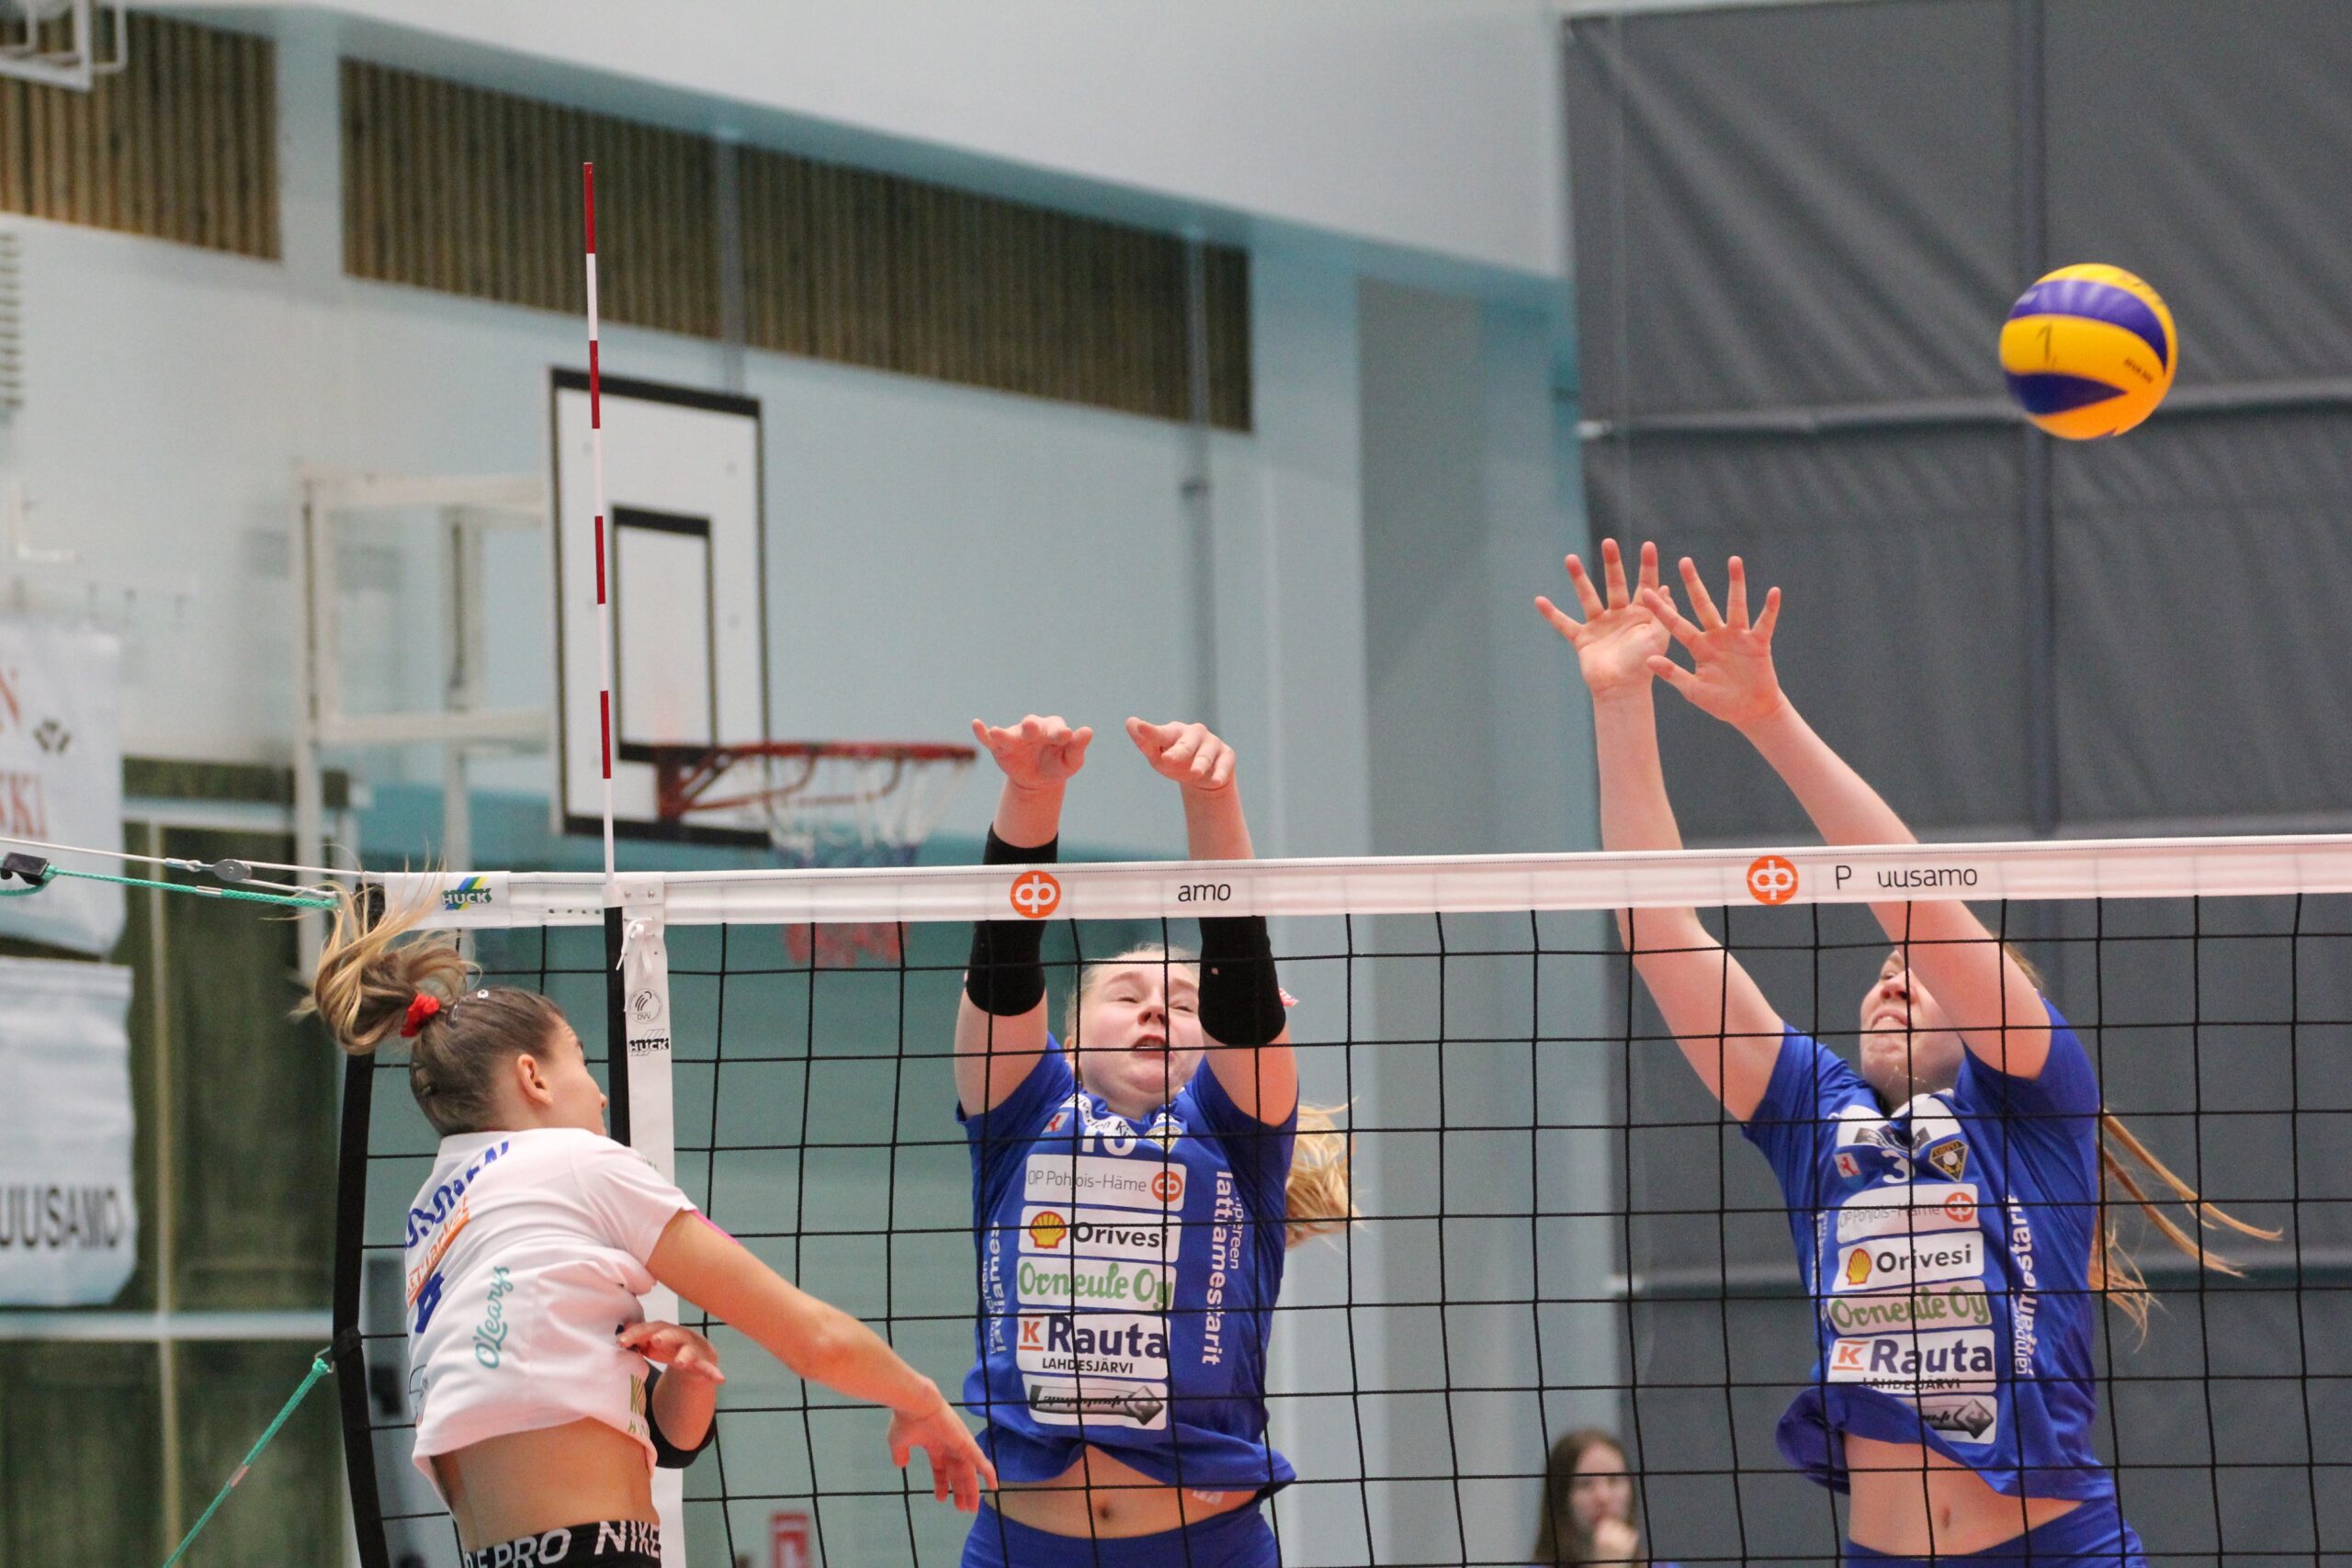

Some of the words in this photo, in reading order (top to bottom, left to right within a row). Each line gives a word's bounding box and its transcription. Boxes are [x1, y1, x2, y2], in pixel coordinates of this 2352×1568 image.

[442, 888, 492, 905] HUCK
[1178, 883, 1231, 902] amo
[628, 1037, 669, 1052] HUCK
[1027, 1169, 1045, 1186] OP
[1046, 1170, 1148, 1192] Pohois-Häme
[1881, 1150, 1916, 1184] 3
[1072, 1222, 1169, 1248] Orivesi
[1229, 1191, 1245, 1269] pereen
[1876, 1244, 1972, 1273] Orivesi
[1133, 1269, 1173, 1311] Oy
[1949, 1286, 1990, 1325] Oy
[1023, 1320, 1041, 1344] K
[1047, 1315, 1168, 1359] Rauta
[1042, 1357, 1134, 1374] LAHDESJÄRVI
[1838, 1345, 1863, 1365] K
[1869, 1338, 1993, 1374] Rauta
[594, 1520, 662, 1559] NIKE
